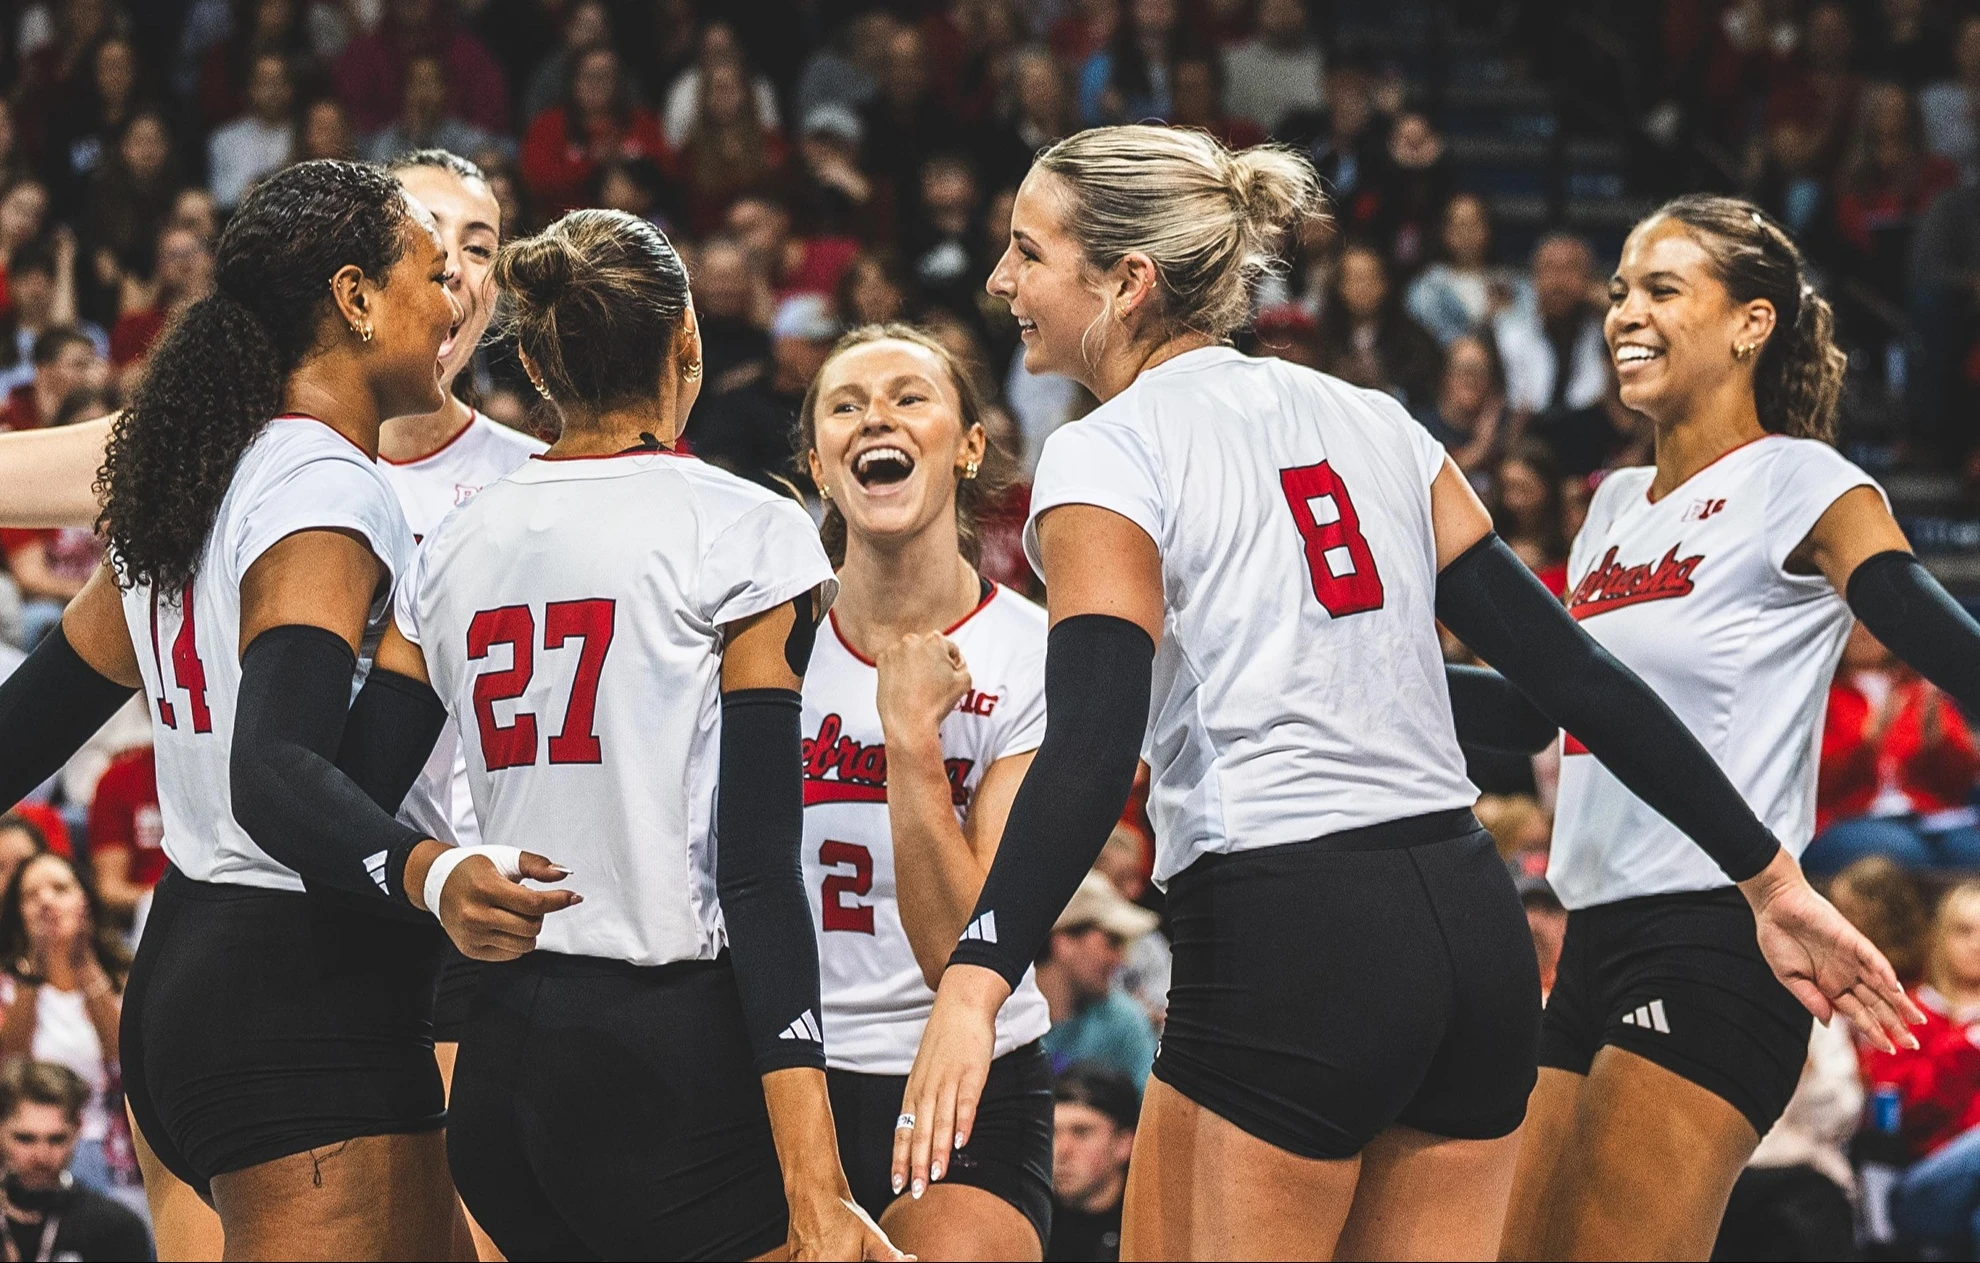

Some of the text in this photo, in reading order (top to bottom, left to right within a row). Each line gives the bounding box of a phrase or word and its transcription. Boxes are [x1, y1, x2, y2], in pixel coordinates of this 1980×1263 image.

[1279, 458, 1384, 620] 8
[466, 597, 617, 772] 27
[801, 712, 976, 807] ebraa
[818, 839, 876, 936] 2
